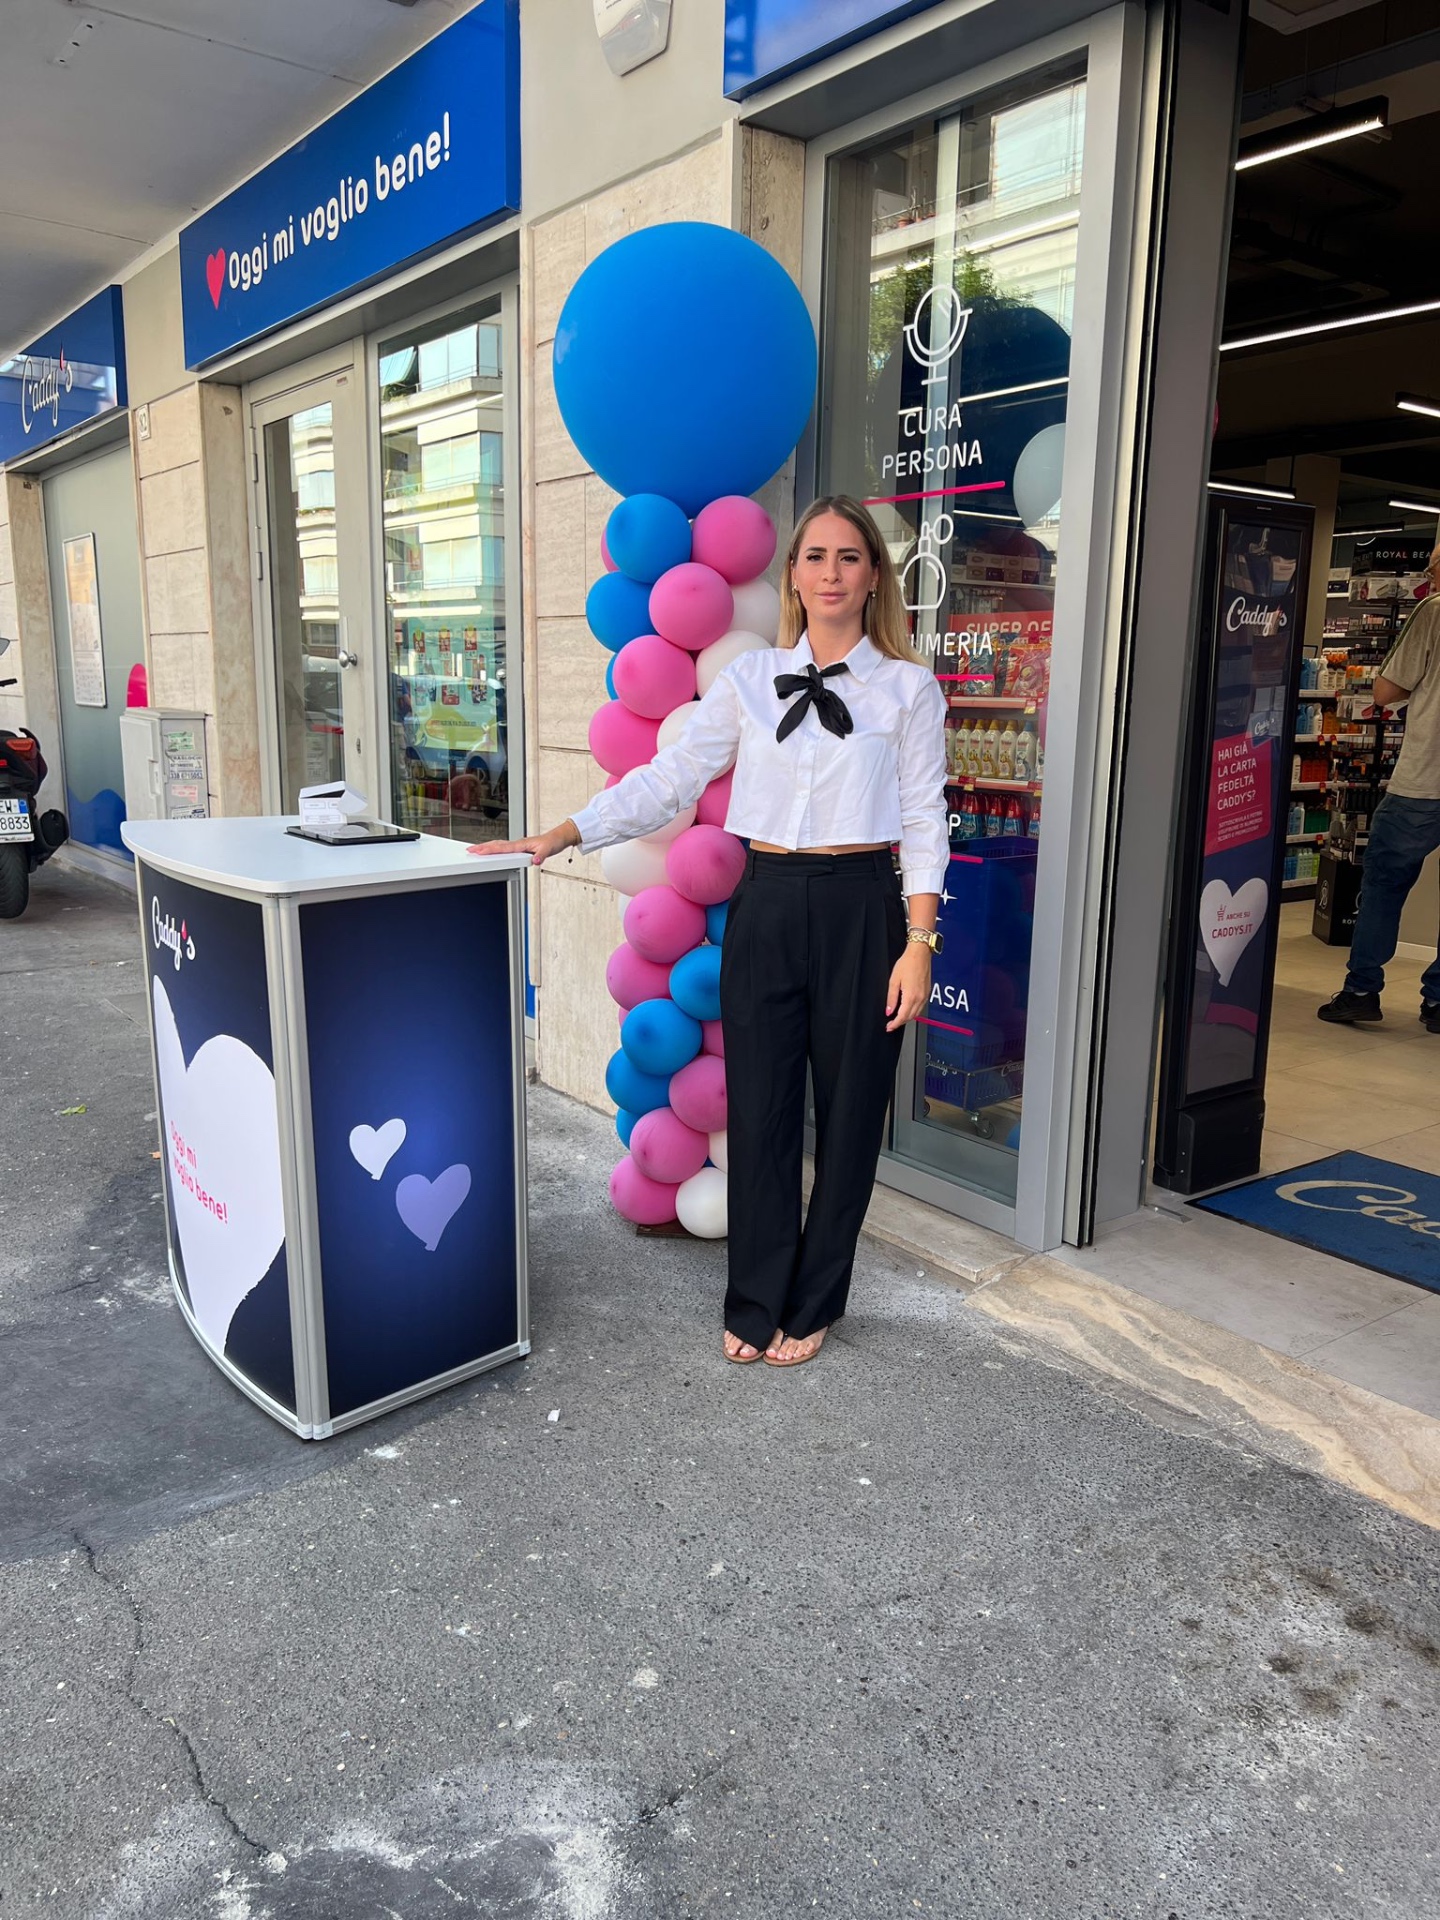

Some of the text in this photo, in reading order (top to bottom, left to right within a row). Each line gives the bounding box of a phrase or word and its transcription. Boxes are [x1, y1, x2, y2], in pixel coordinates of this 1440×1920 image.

[229, 111, 450, 291] Oggi mi voglio bene!
[21, 341, 73, 434] Caddy's
[904, 403, 962, 437] CURA
[882, 440, 982, 479] PERSONA
[1376, 551, 1408, 559] ROYAL
[1226, 596, 1288, 637] Caddy's
[1217, 757, 1257, 778] LA CARTA
[1218, 741, 1248, 761] HAI GIÀ
[1217, 772, 1255, 794] FEDELTÀ
[1217, 790, 1257, 811] CADDY'S?
[152, 896, 196, 971] Caddy's
[187, 1147, 197, 1169] mi
[195, 1177, 228, 1224] bene!
